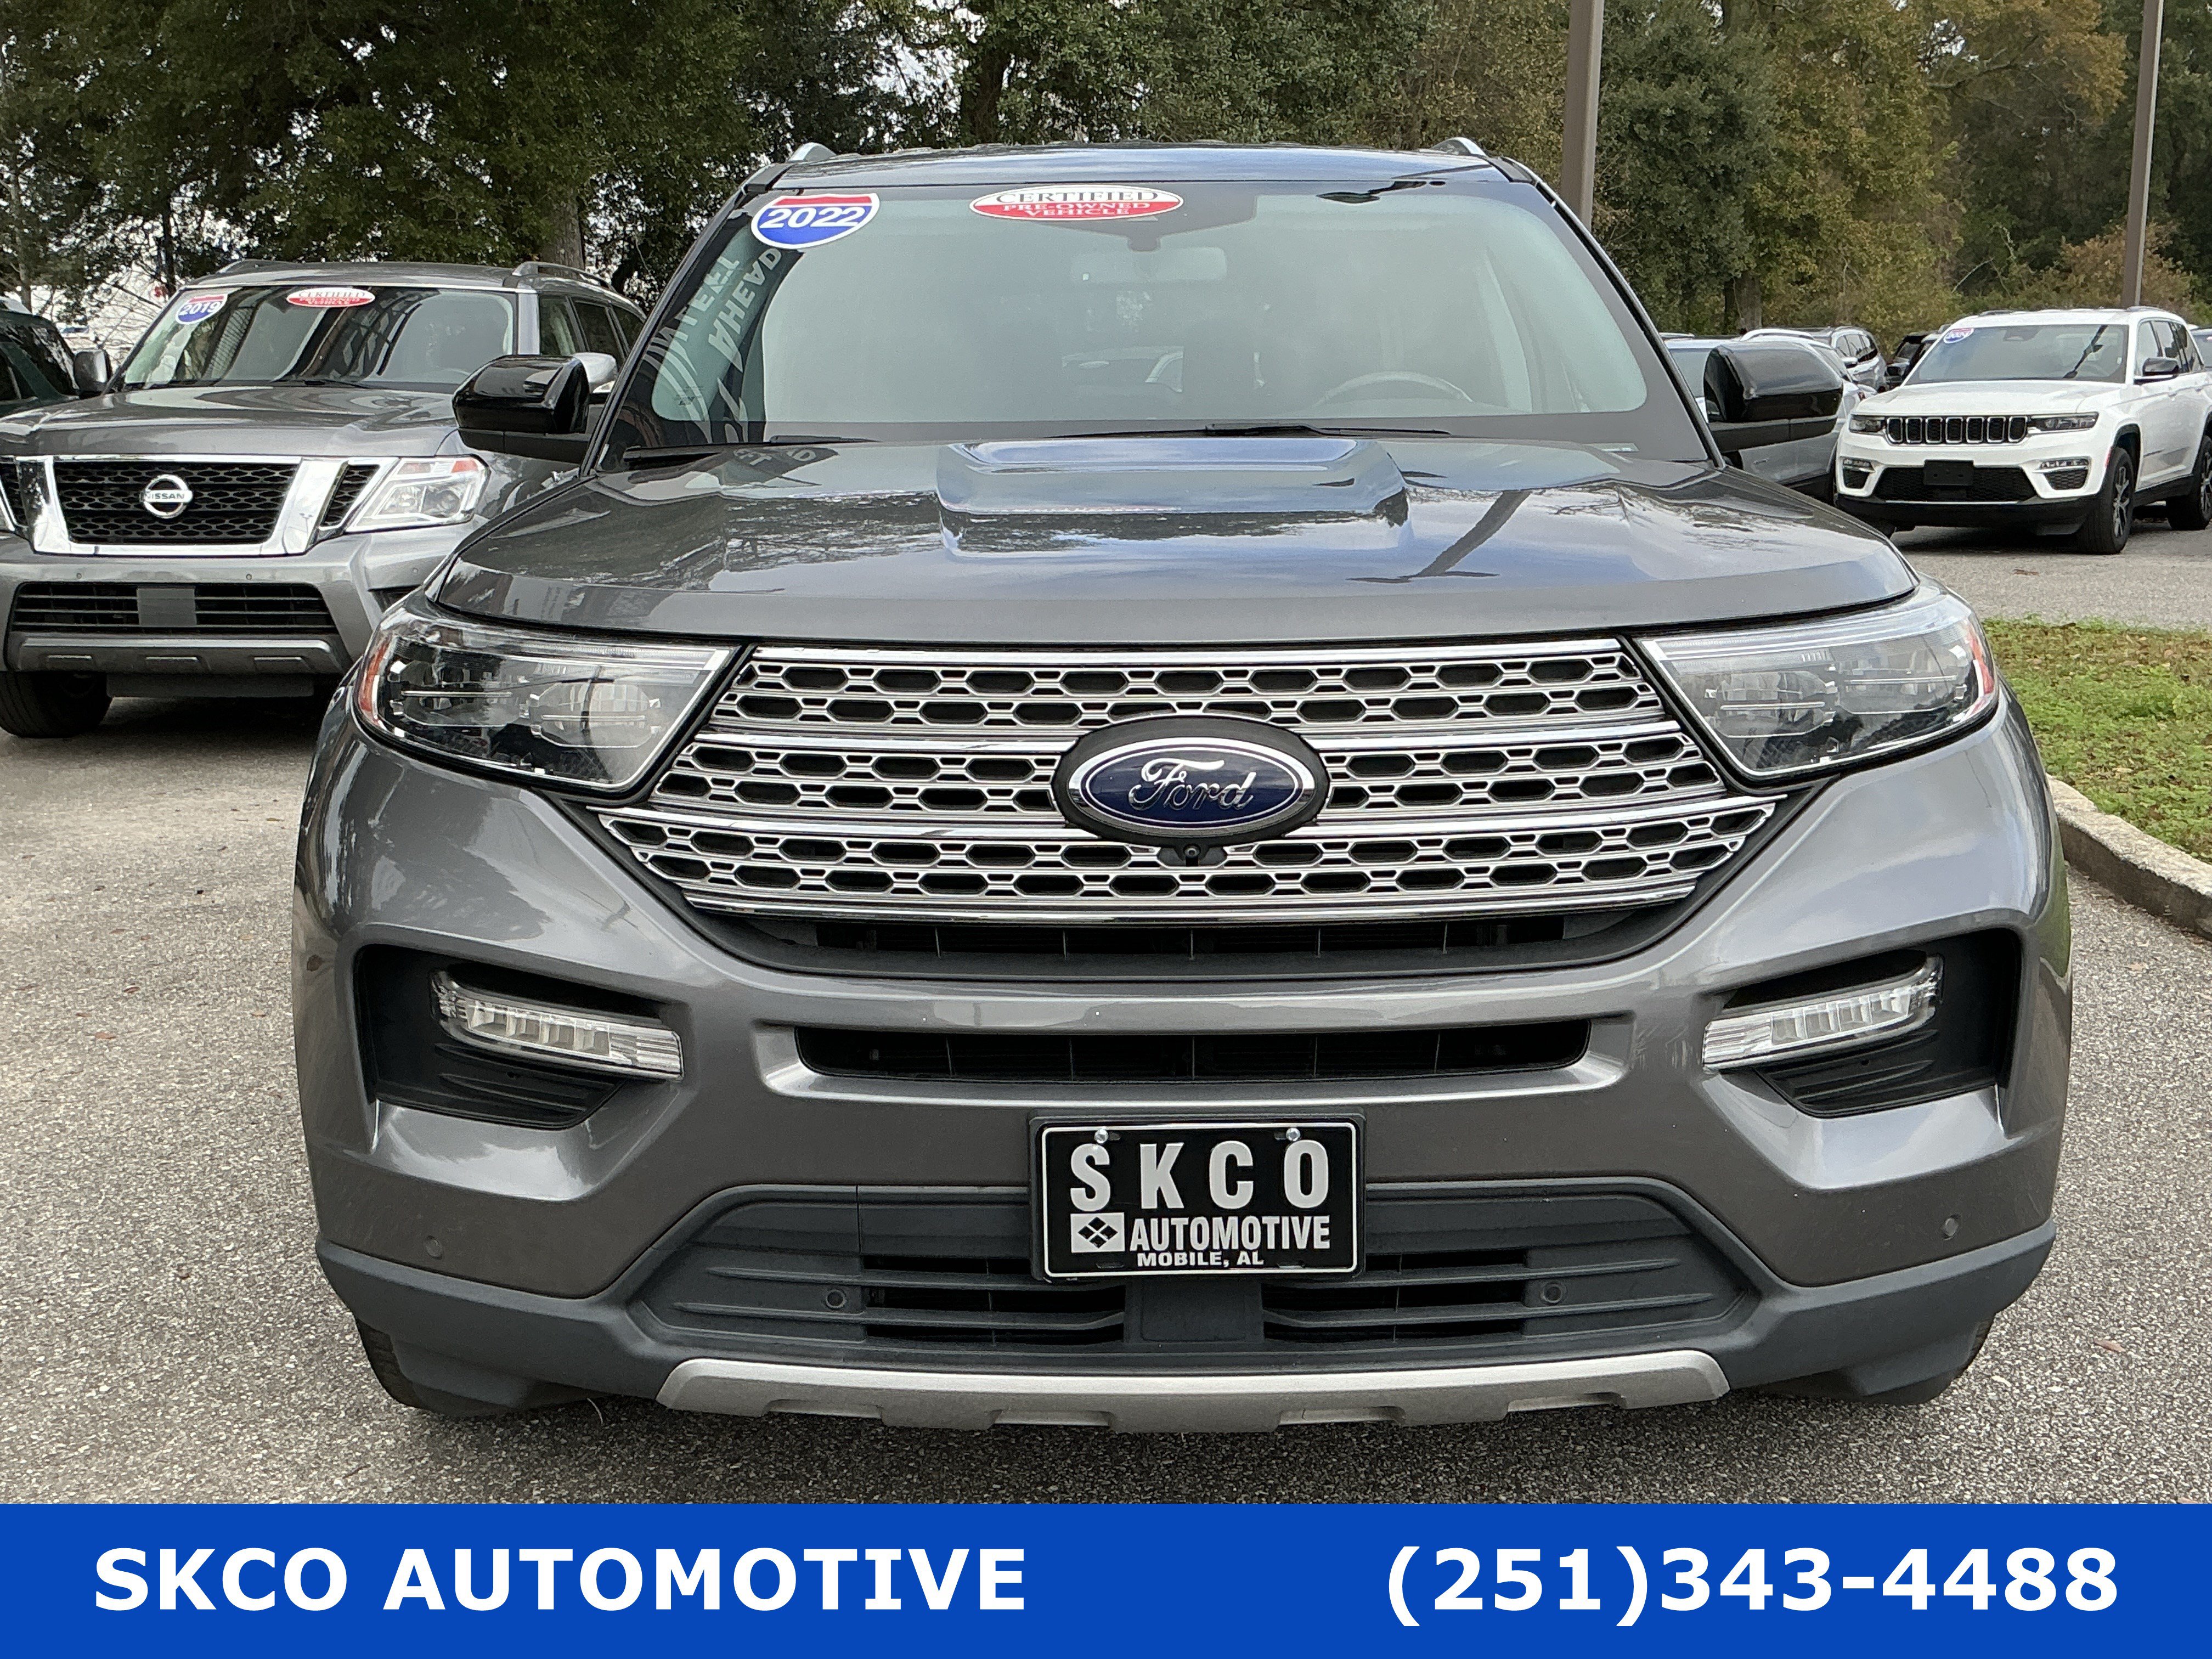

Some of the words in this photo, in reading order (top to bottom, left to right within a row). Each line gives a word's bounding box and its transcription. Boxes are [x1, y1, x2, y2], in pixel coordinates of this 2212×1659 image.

[996, 191, 1158, 202] CERTIFIED
[1003, 203, 1150, 211] PRE-OWNED
[759, 206, 865, 228] 2022
[178, 301, 221, 315] 2019
[1128, 758, 1257, 811] Ford
[1130, 1215, 1331, 1251] AUTOMOTIVE
[1137, 1251, 1229, 1268] MOBILE,
[1237, 1251, 1264, 1266] AL
